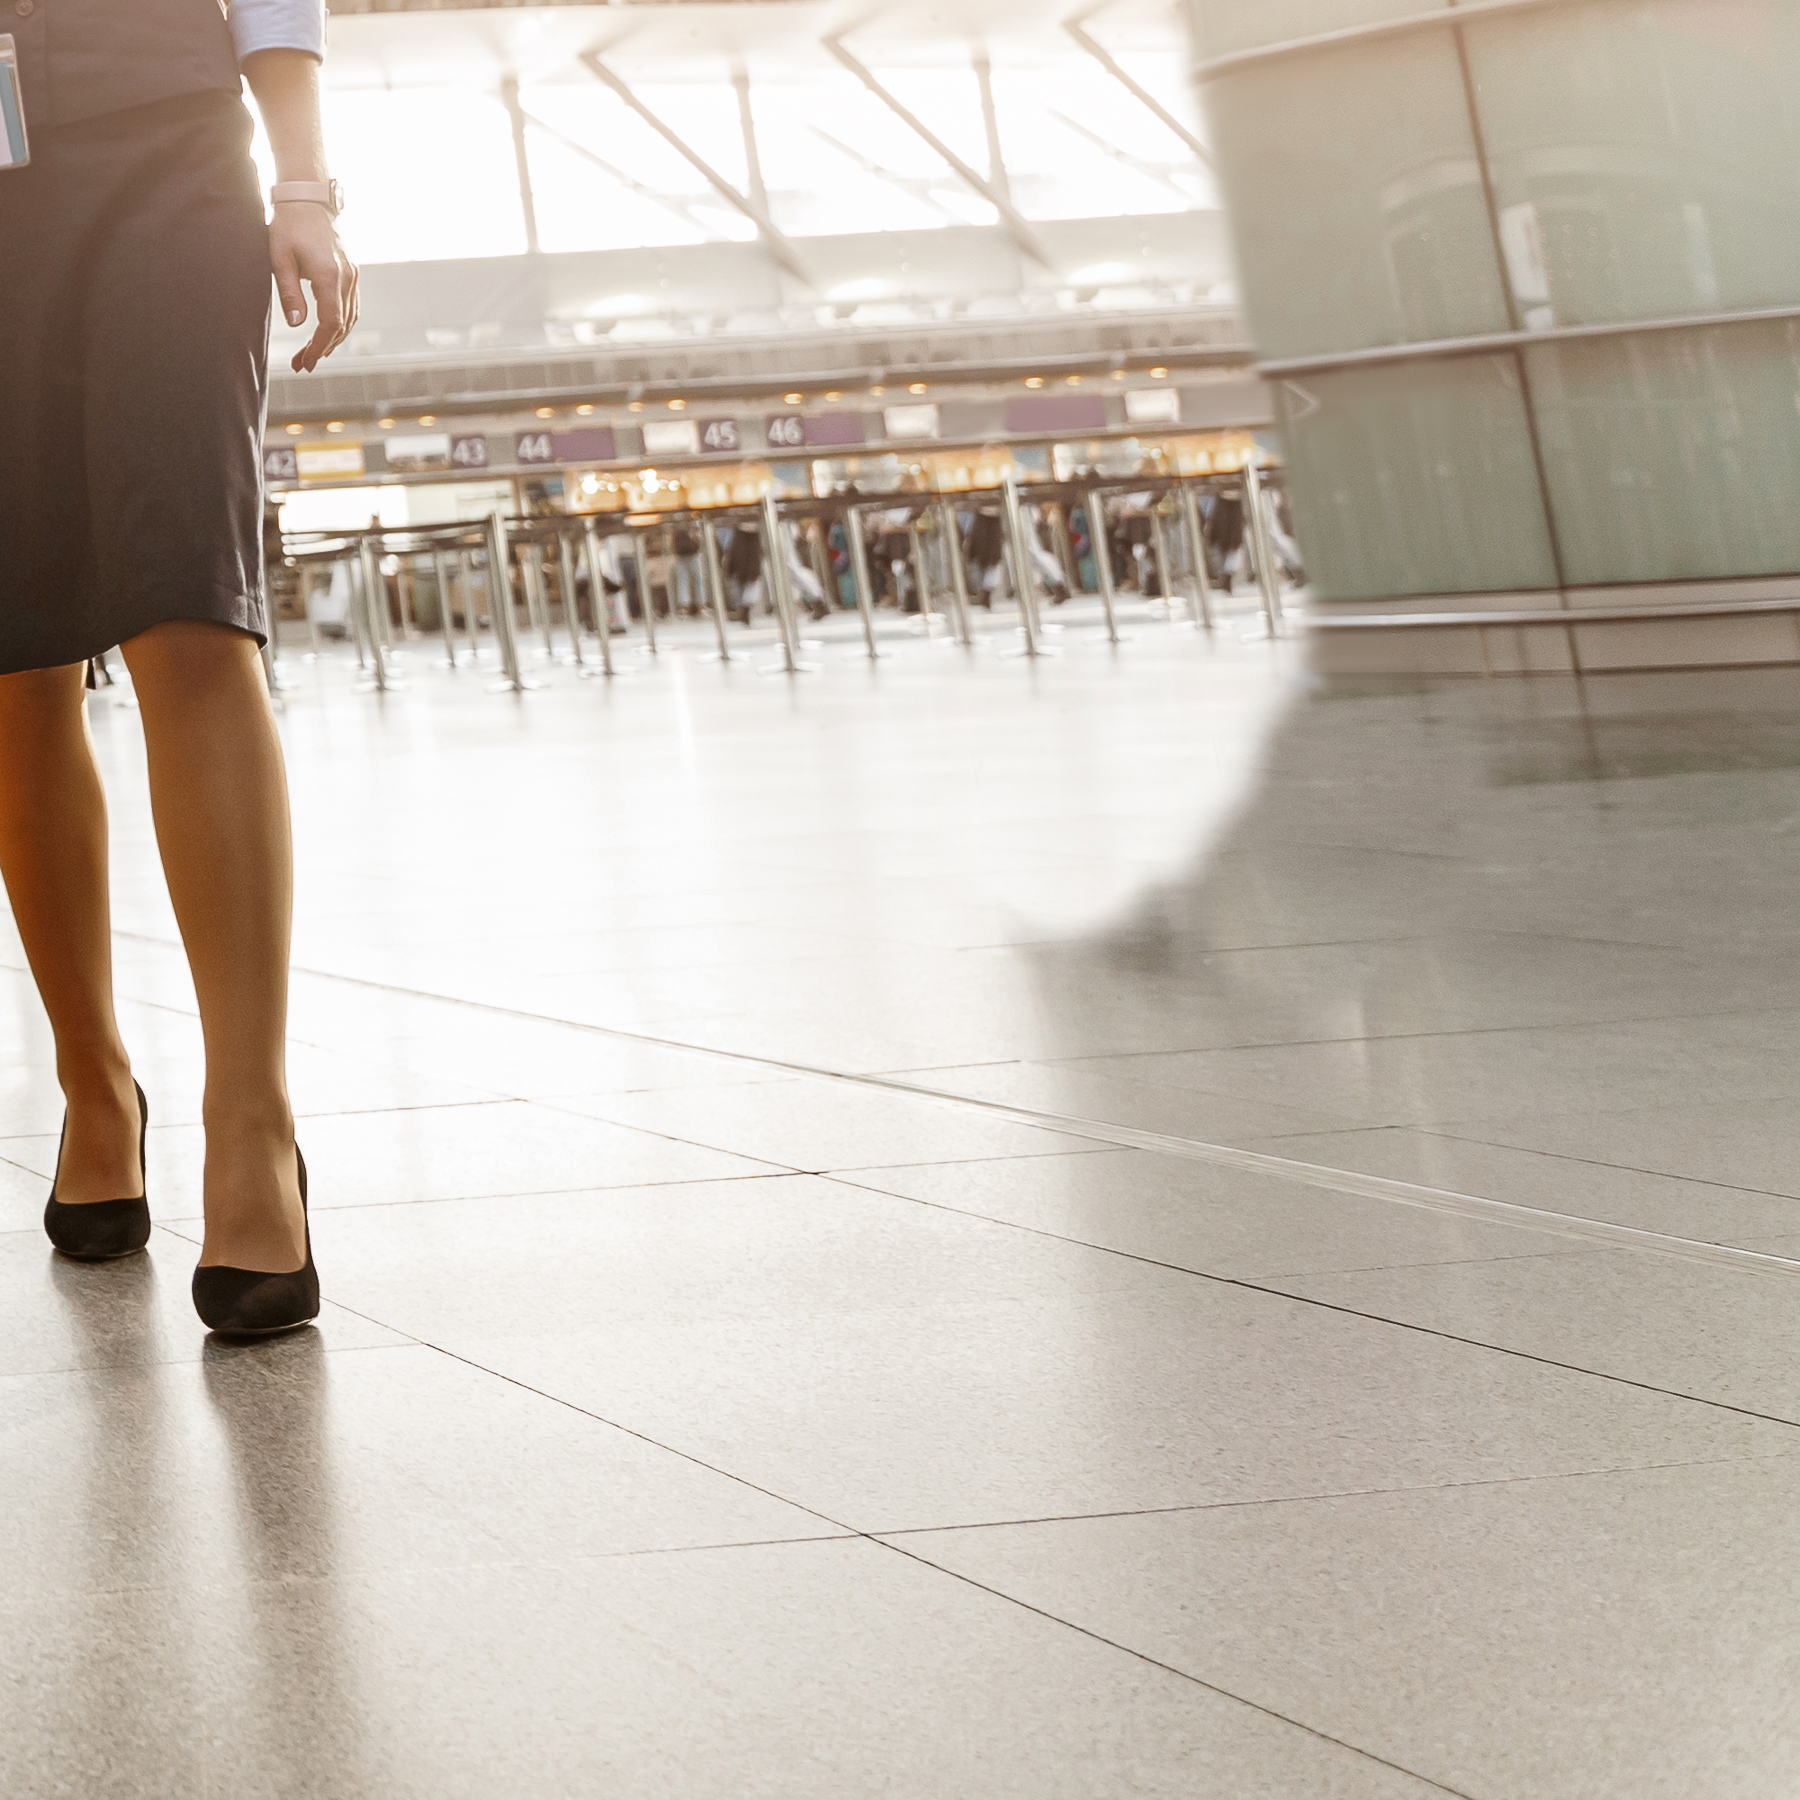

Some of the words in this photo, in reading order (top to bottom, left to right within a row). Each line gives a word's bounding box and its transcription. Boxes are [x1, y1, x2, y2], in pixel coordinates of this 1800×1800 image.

[704, 421, 736, 448] 45
[768, 417, 801, 445] 46
[453, 438, 487, 465] 43
[517, 434, 550, 461] 44
